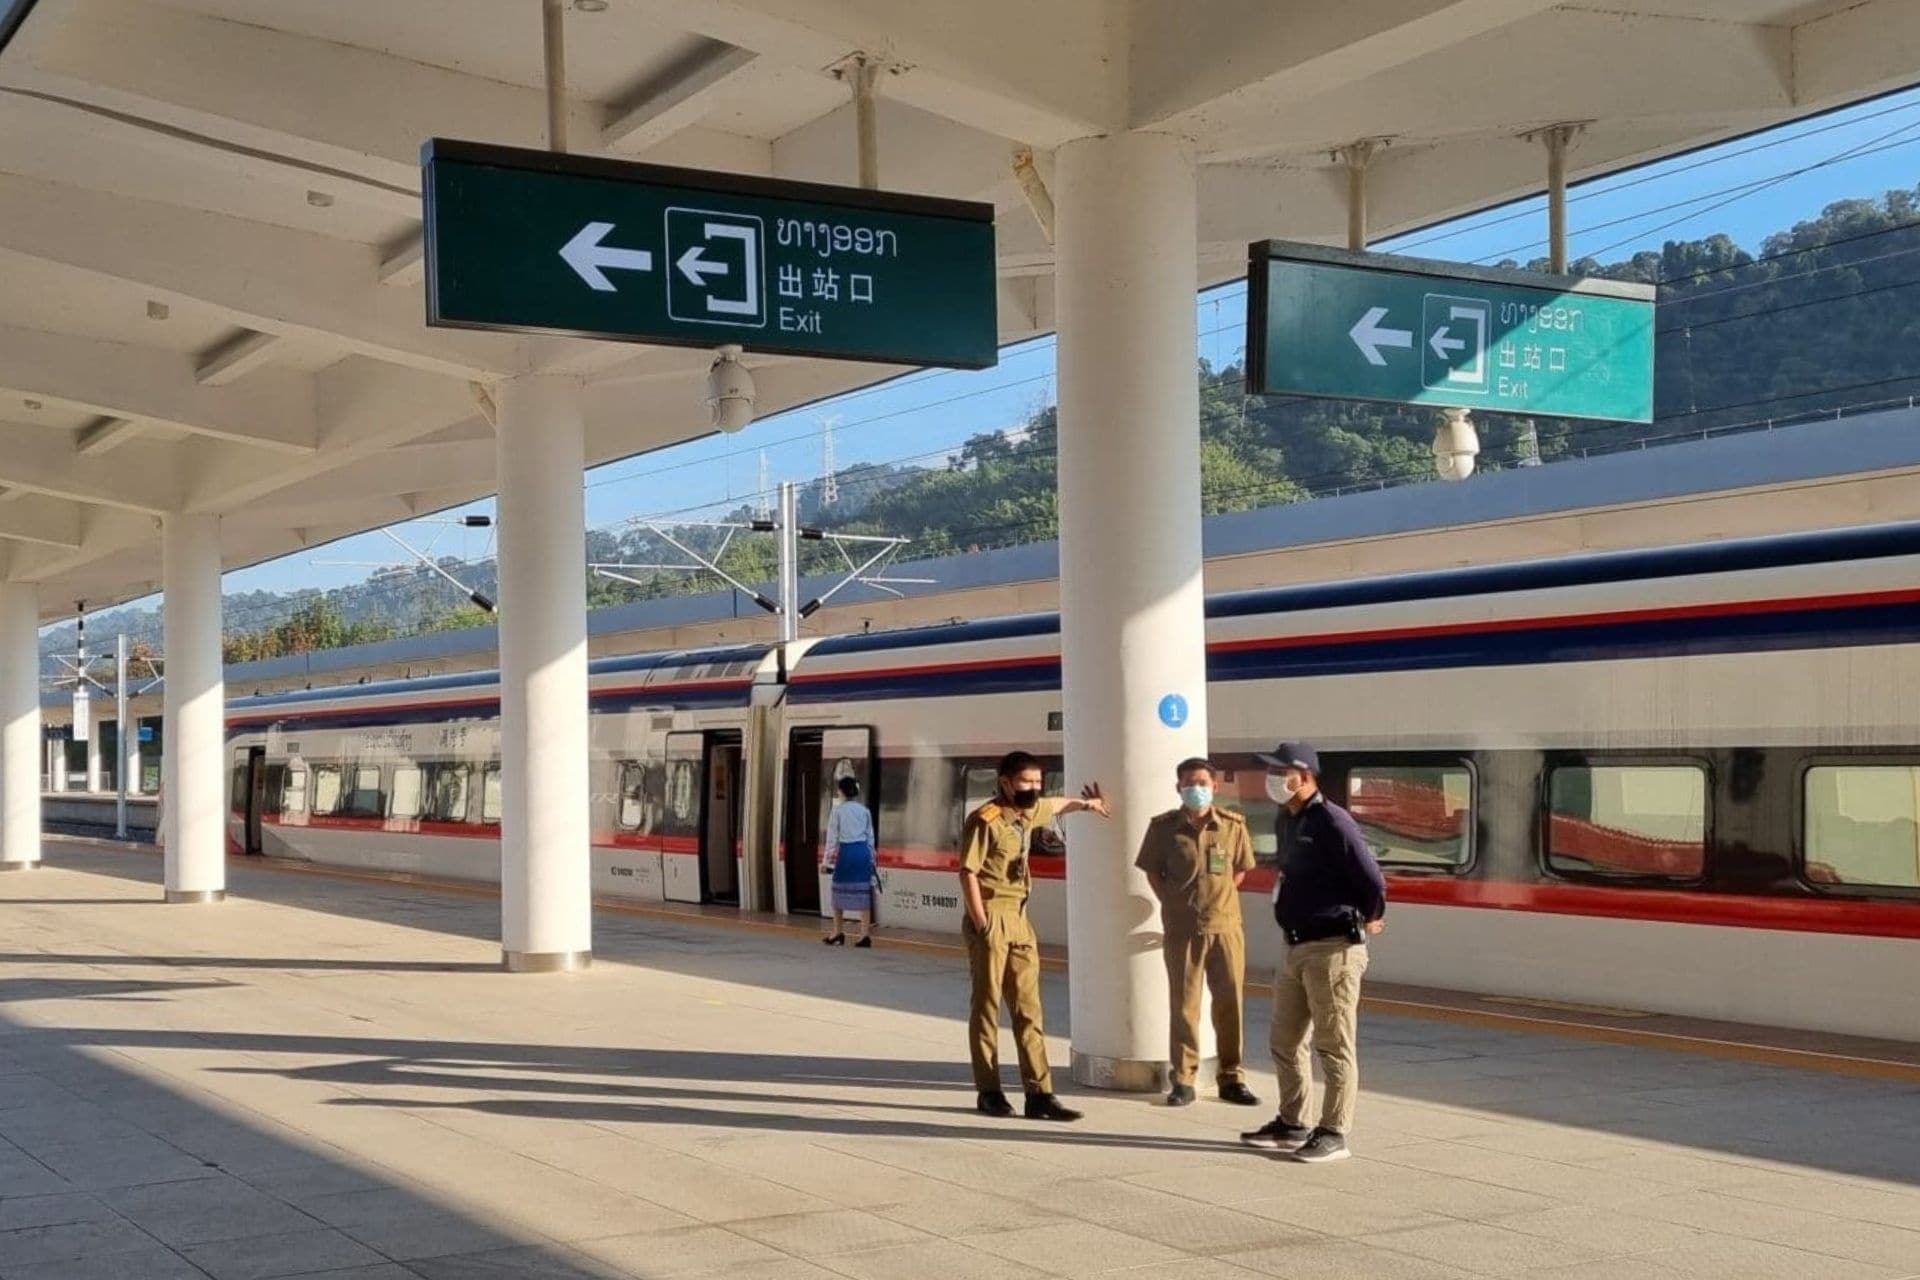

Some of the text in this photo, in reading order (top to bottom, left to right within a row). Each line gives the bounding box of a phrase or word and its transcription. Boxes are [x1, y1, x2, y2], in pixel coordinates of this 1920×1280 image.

[777, 217, 897, 258] ທາງອອກ
[778, 264, 874, 304] 出站口
[779, 306, 823, 334] Exit
[1500, 302, 1585, 335] ທາງອອກ
[1499, 340, 1566, 371] 出站口
[1498, 376, 1529, 399] Exit
[1169, 703, 1180, 721] 1
